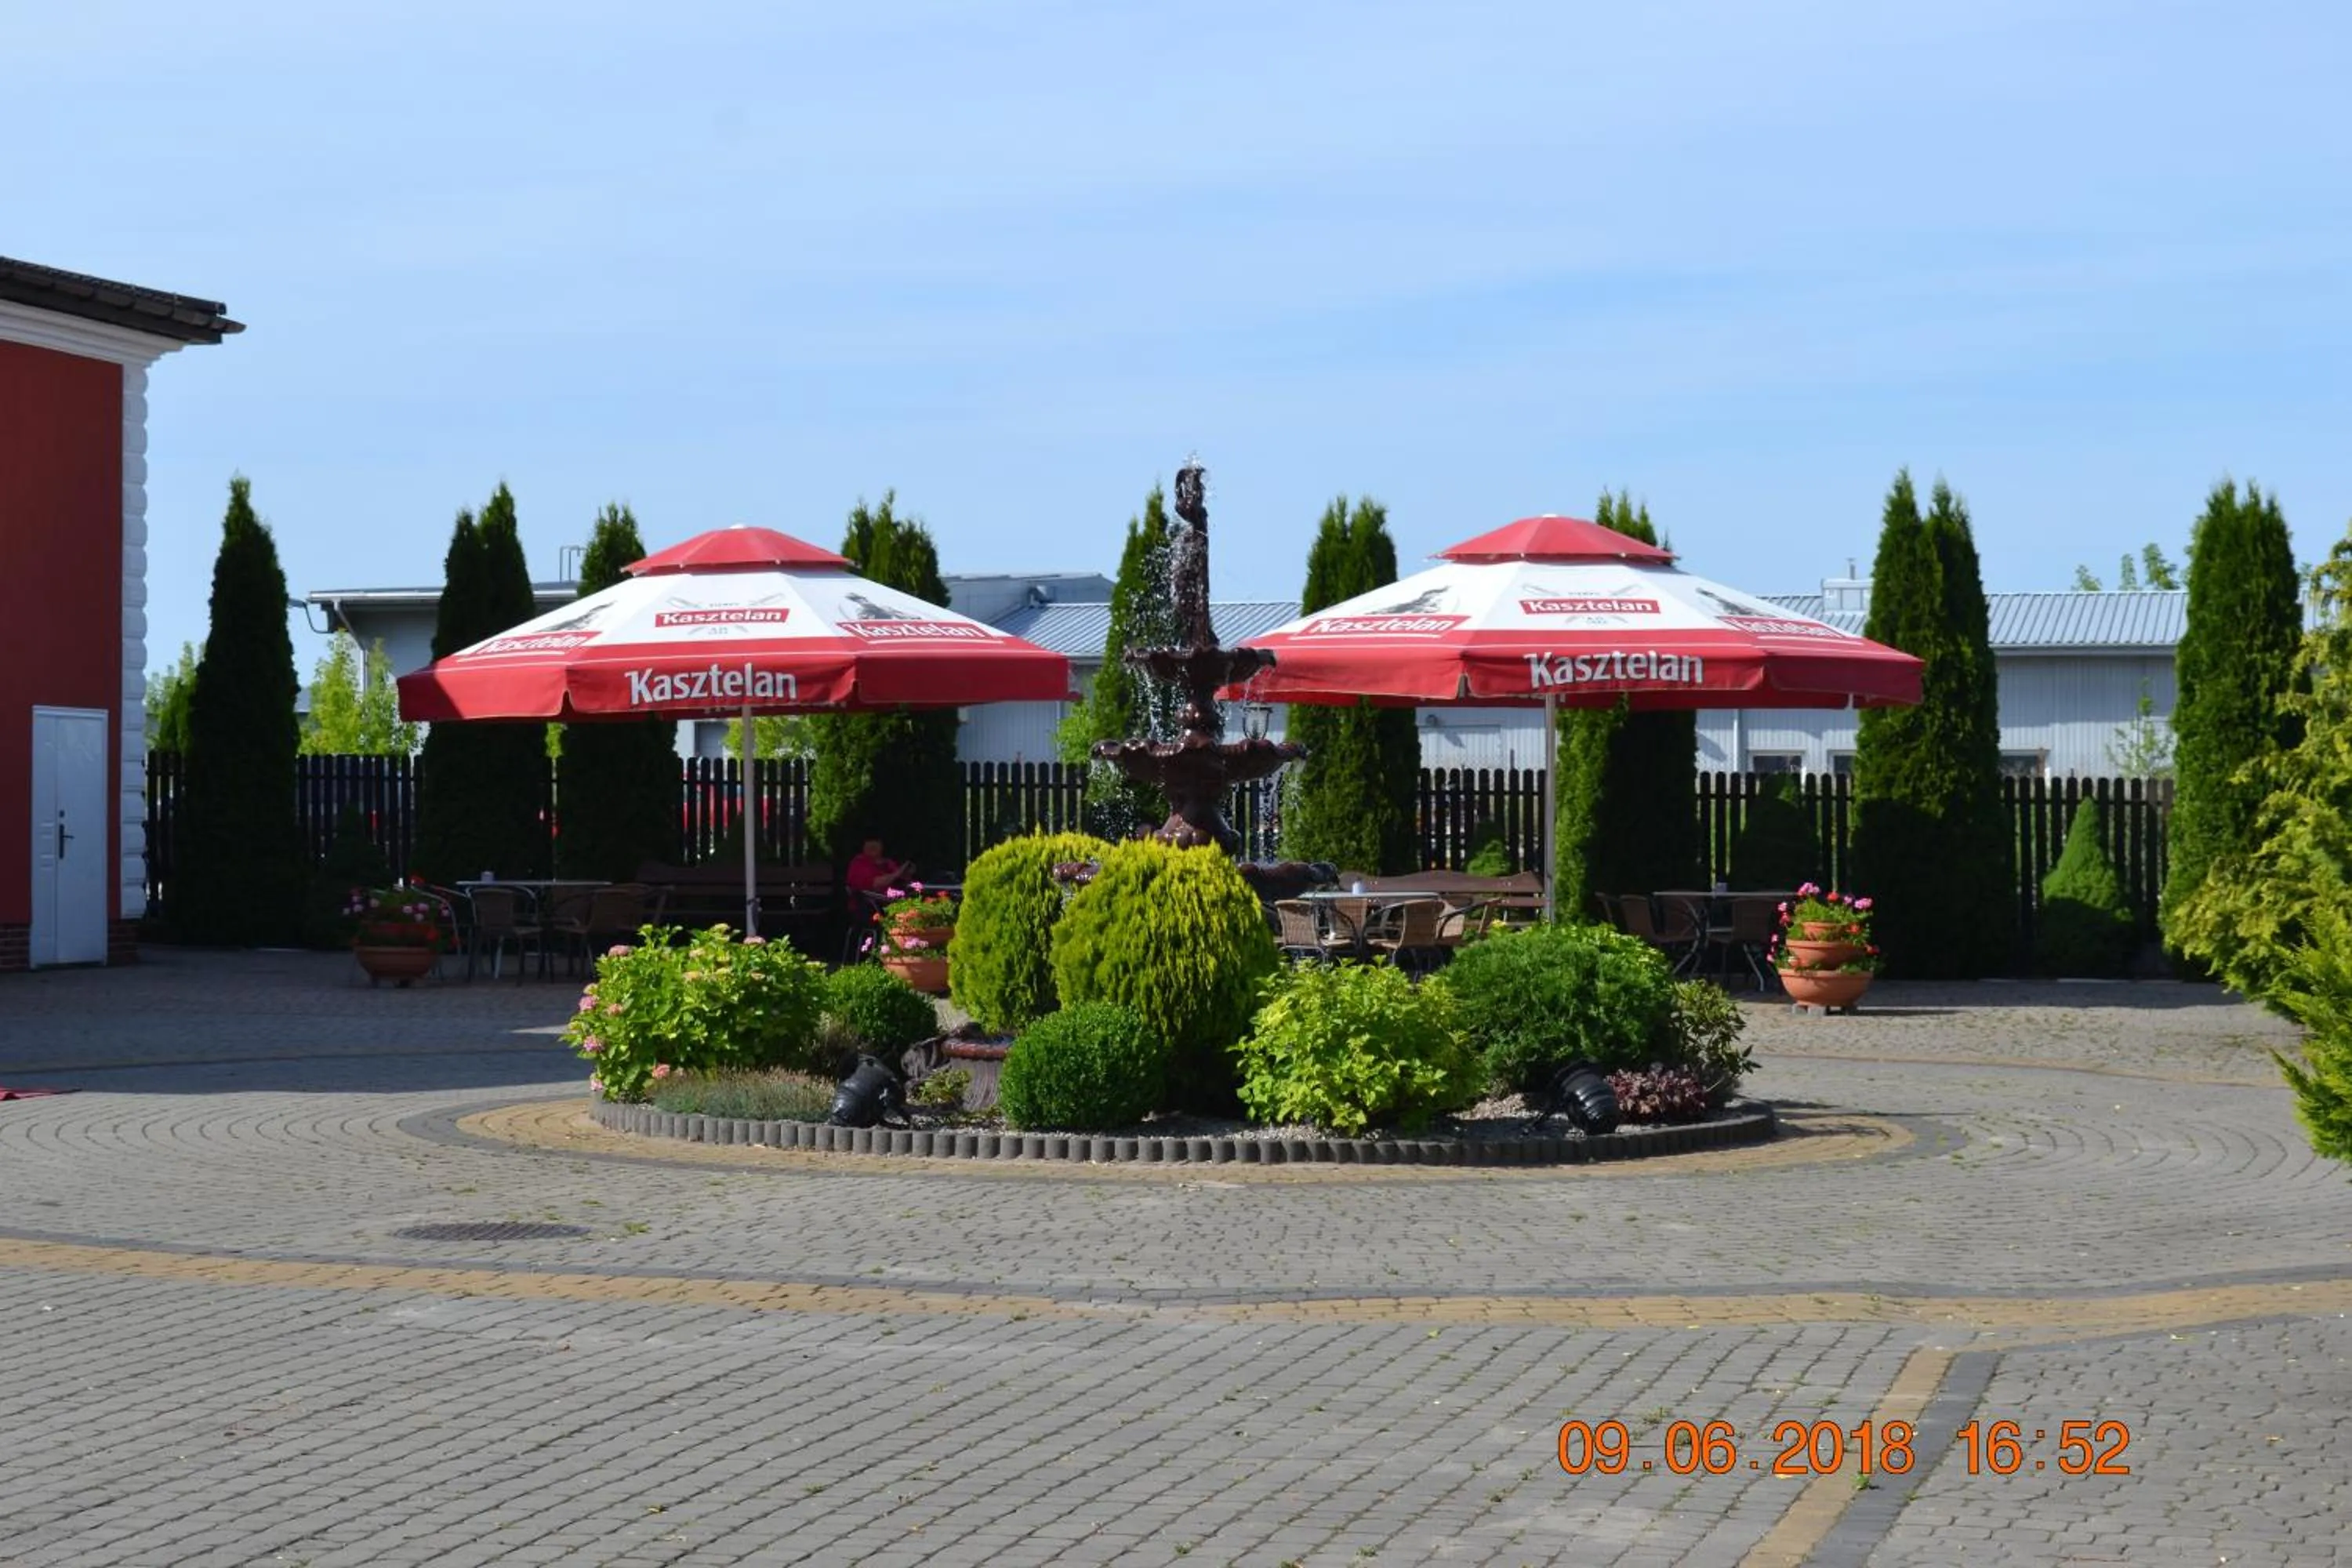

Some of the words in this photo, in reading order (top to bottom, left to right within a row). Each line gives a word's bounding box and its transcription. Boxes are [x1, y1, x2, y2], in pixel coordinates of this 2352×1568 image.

[1523, 599, 1652, 612] Kasztelan
[661, 609, 782, 625] Kasztelan
[1308, 615, 1455, 633] Kasztelan
[842, 622, 985, 637] Kasztelan
[1523, 650, 1703, 688] Kasztelan
[624, 662, 797, 705] Kasztelan
